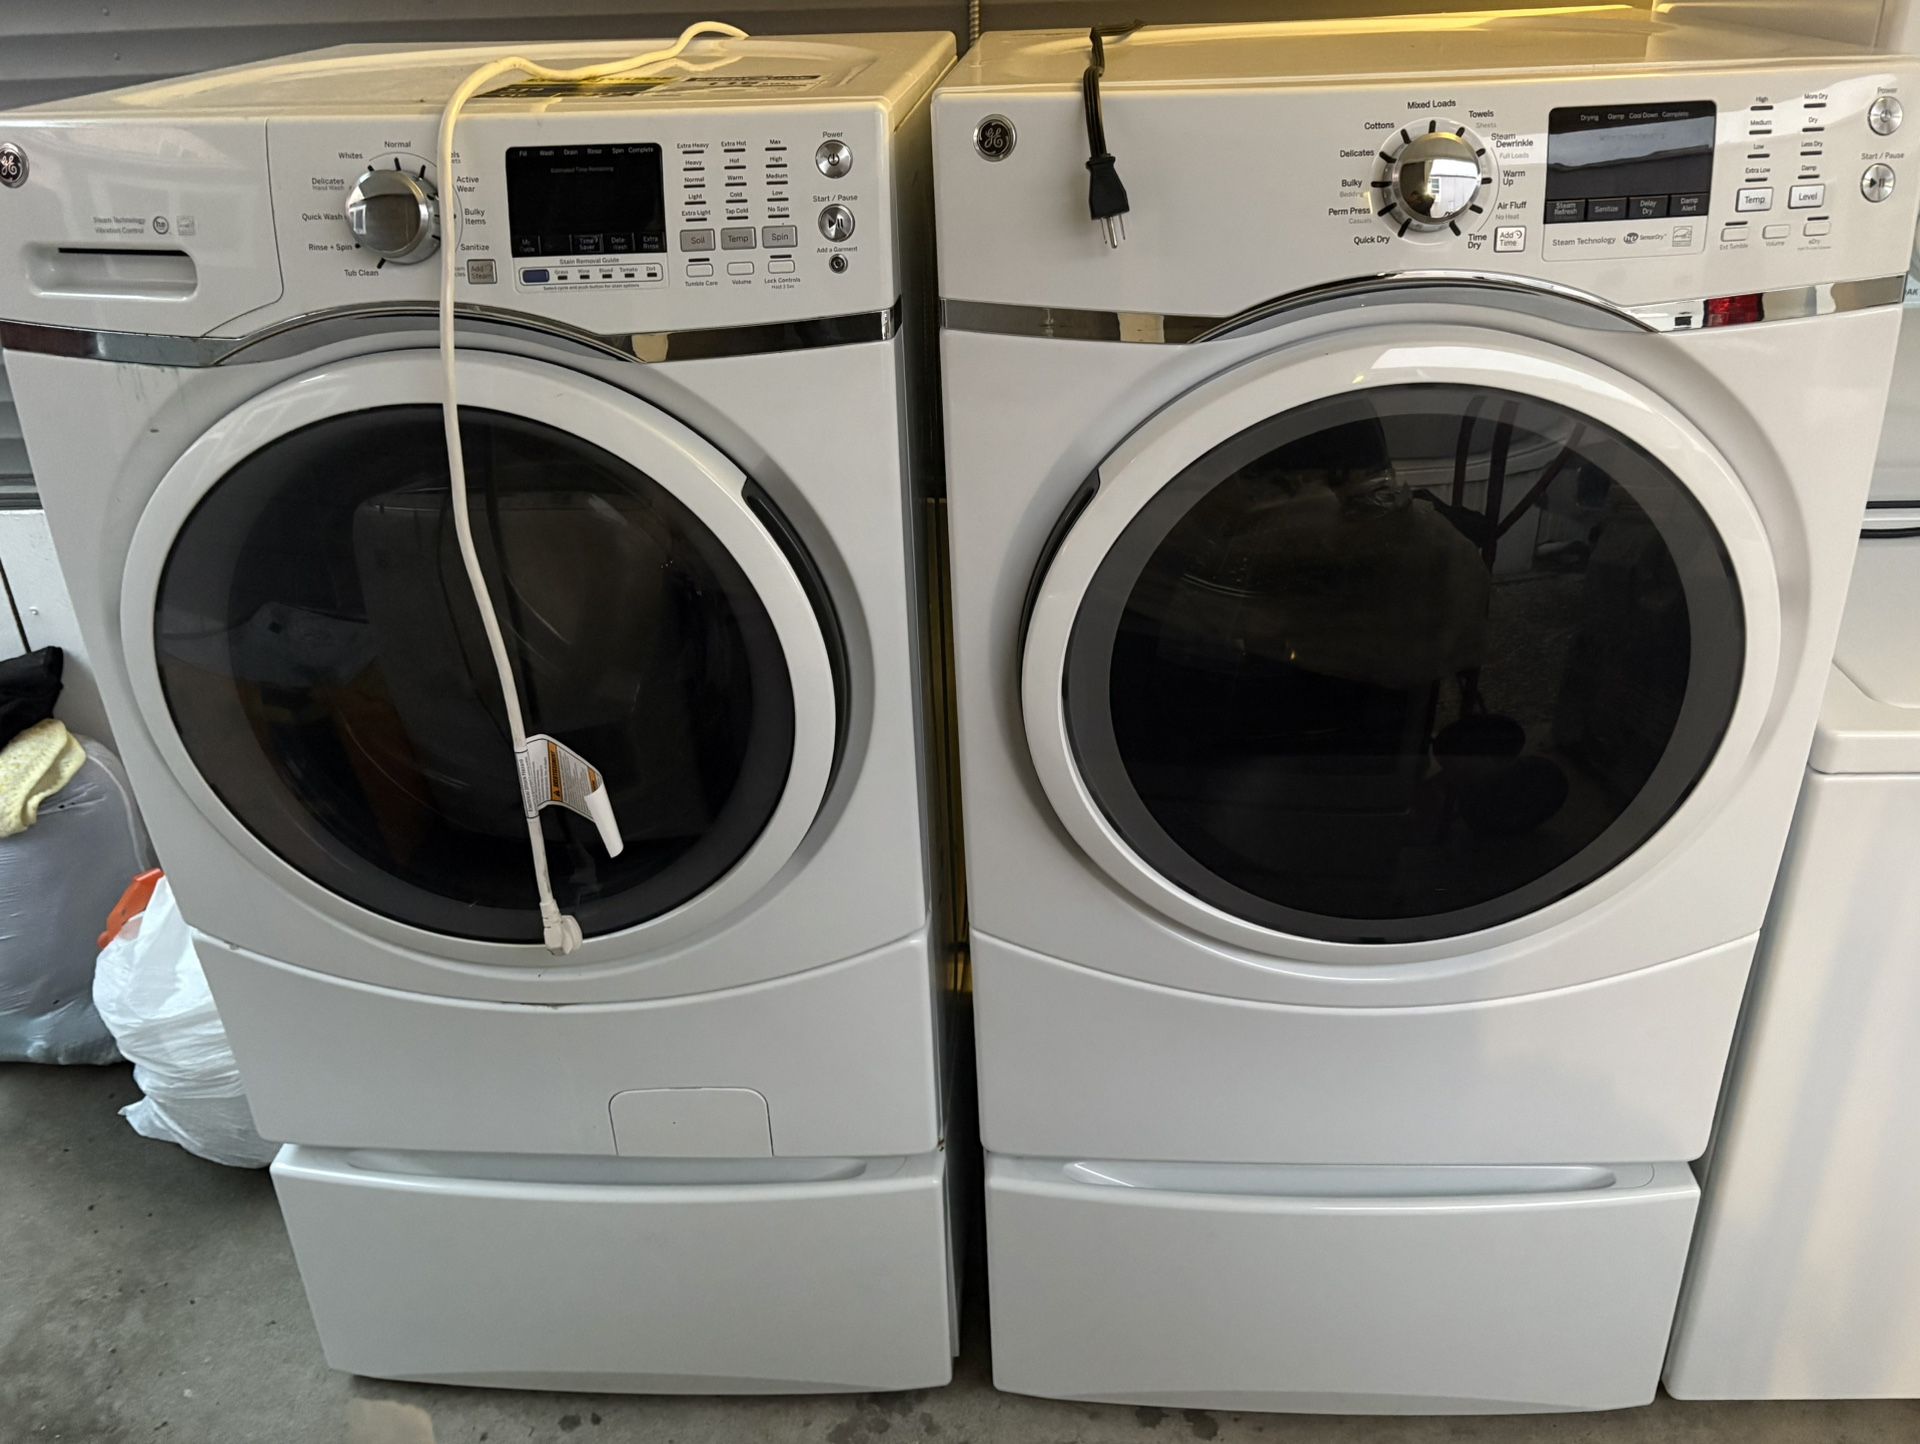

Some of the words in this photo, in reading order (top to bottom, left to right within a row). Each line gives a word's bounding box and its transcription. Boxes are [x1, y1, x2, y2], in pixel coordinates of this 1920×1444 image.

[1407, 101, 1430, 109] Mixed
[1432, 99, 1456, 108] Loads
[1468, 110, 1494, 118] Towels
[1580, 114, 1600, 122] Drying
[1607, 113, 1625, 121] Damp
[1364, 122, 1394, 130] Cottons
[1496, 139, 1533, 148] Dewrinkle
[1813, 140, 1823, 148] Dry
[628, 146, 653, 154] Complete
[1340, 150, 1374, 158] Delicates
[1342, 179, 1362, 188] Bulky
[812, 195, 830, 203] Start
[1681, 197, 1698, 205] Damp
[1745, 196, 1765, 204] Temp
[1497, 202, 1509, 210] Air
[1640, 200, 1657, 208] Delay
[1681, 204, 1696, 212] Alert
[464, 208, 485, 217] Bulky
[302, 213, 322, 221] Quick
[728, 235, 749, 243] Temp
[771, 233, 789, 242] Spin
[1354, 236, 1375, 245] Quick
[1377, 235, 1390, 244] Dry
[1468, 233, 1487, 241] Time
[1552, 239, 1576, 247] Steam
[1577, 236, 1616, 245] Technology
[336, 244, 352, 252] Spin
[1467, 242, 1481, 250] Dry
